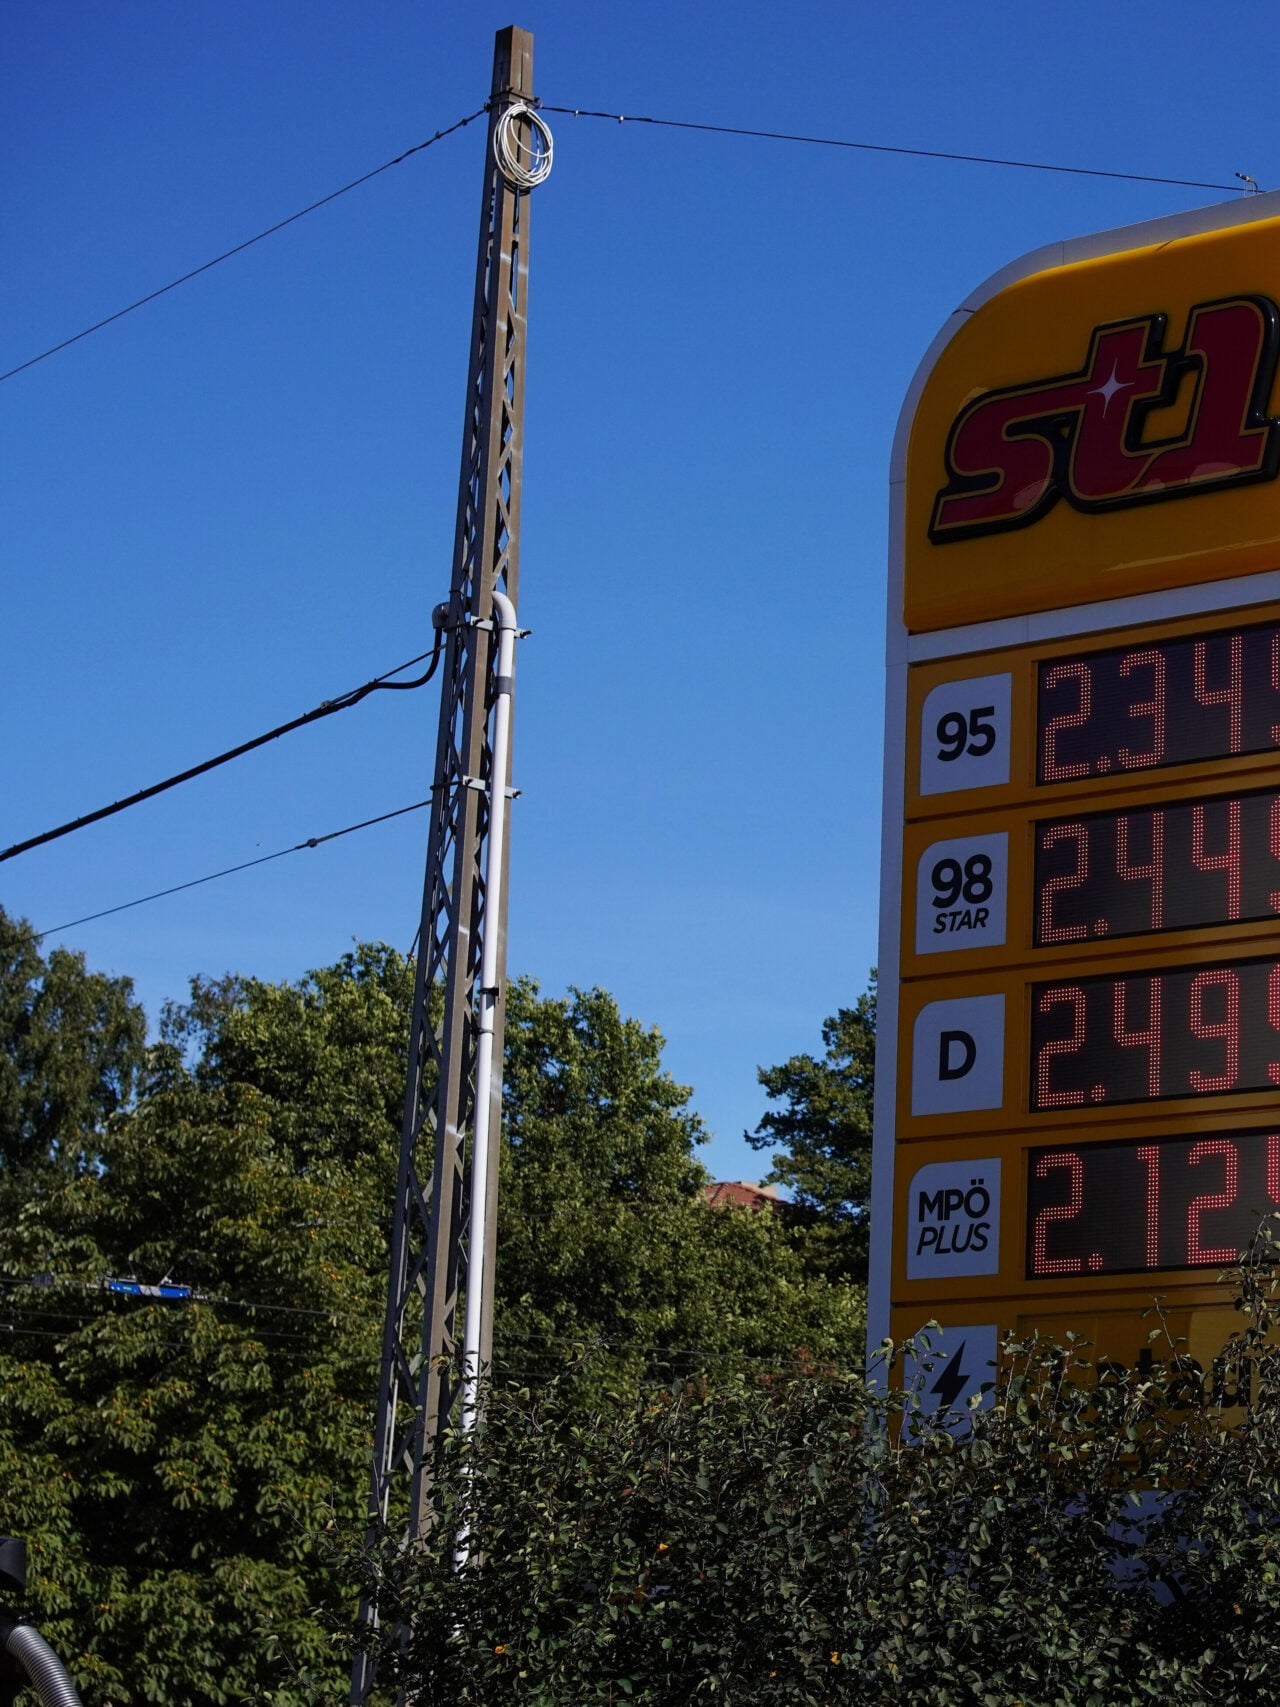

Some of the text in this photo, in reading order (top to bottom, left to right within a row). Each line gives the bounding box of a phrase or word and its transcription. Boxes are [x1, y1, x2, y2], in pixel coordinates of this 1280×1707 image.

[936, 705, 996, 762] 95
[931, 853, 993, 908] 98
[932, 907, 990, 935] STAR
[938, 1030, 977, 1081] D
[918, 1178, 991, 1223] MPÖ
[916, 1222, 991, 1256] PLUS
